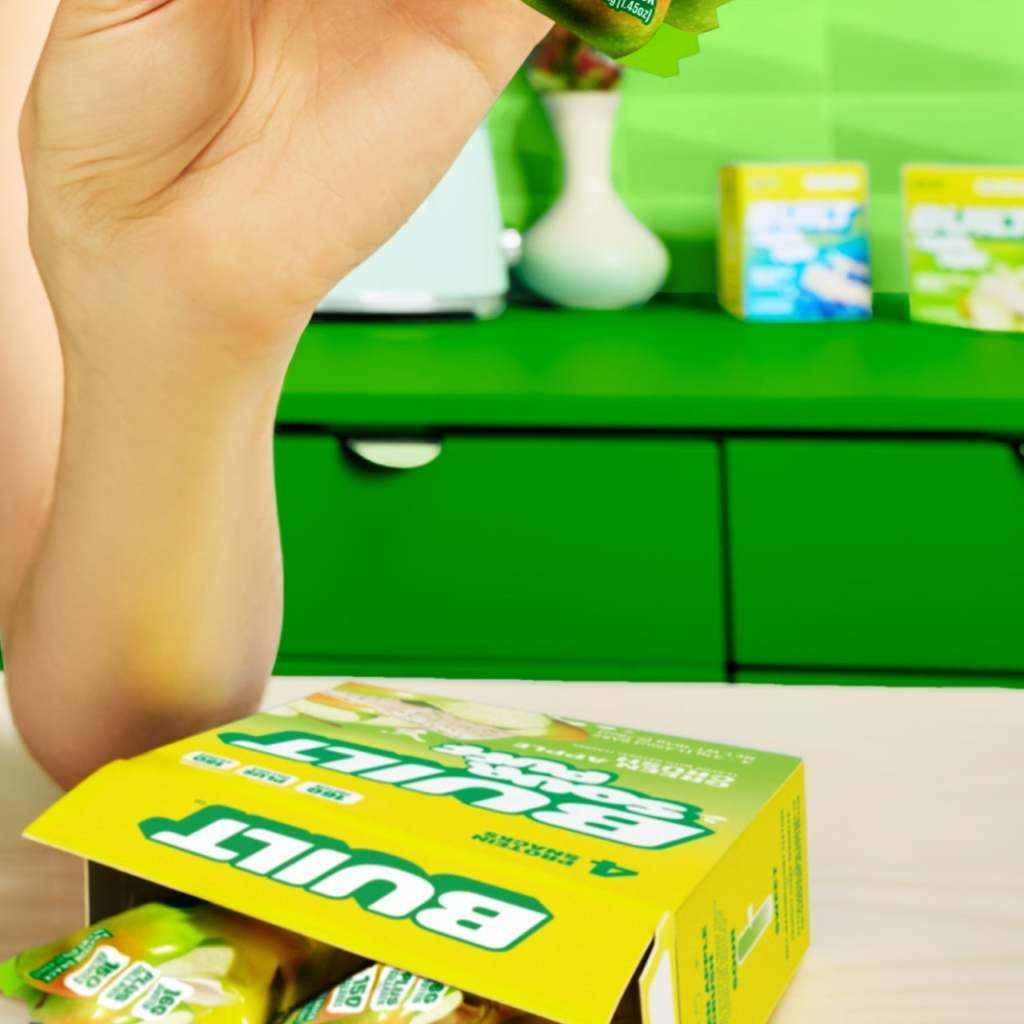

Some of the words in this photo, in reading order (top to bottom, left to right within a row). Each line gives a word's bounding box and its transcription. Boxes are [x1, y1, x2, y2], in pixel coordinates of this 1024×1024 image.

[227, 738, 707, 849] BUILT
[149, 818, 550, 950] BUILT
[588, 859, 639, 877] 4
